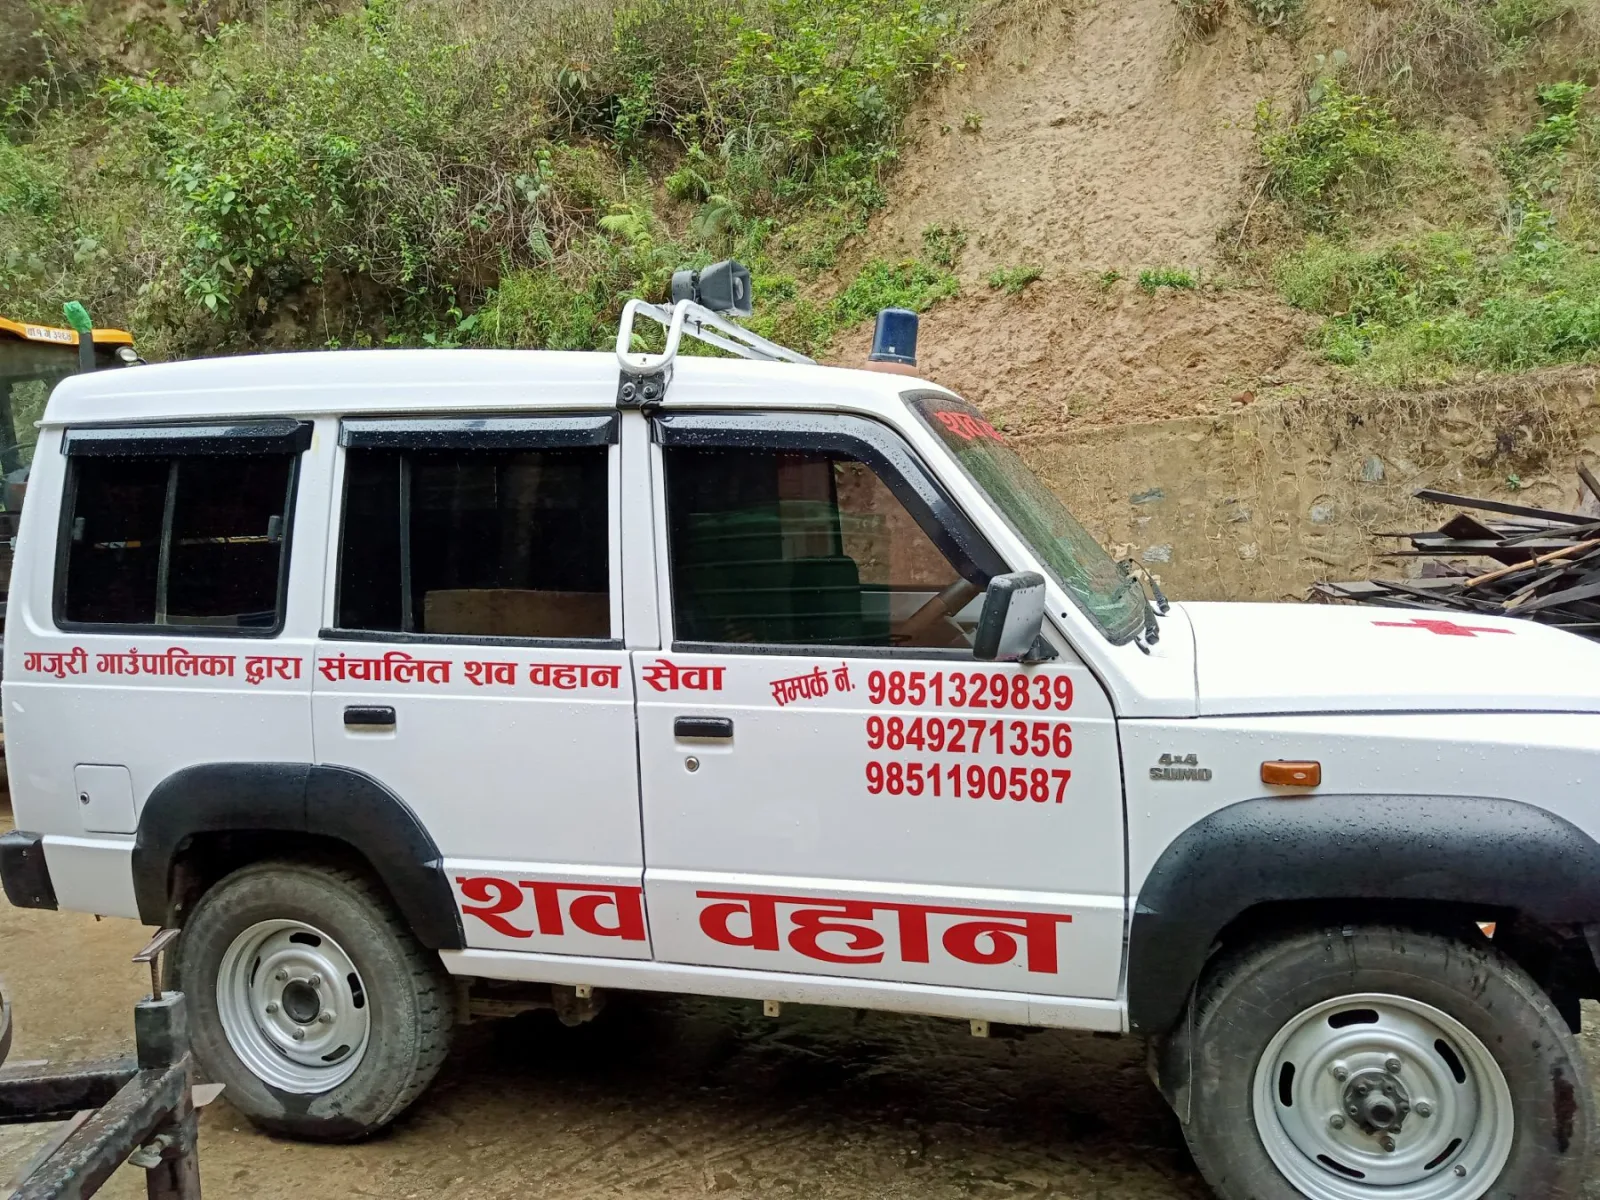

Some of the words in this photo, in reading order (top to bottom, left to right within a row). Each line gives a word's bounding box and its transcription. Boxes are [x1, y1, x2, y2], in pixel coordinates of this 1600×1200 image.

[24, 646, 88, 679] गजुरी
[96, 647, 236, 677] गाउँपालिका
[317, 651, 453, 684] संचालित
[464, 661, 518, 686] शव
[529, 663, 622, 690] वहान
[642, 658, 726, 693] सेवा
[769, 666, 827, 707] सम्पर्क
[867, 669, 1074, 711] 9851329839
[866, 715, 1073, 758] 9849271356
[865, 761, 1072, 804] 9851190587
[1149, 767, 1213, 781] SUMO
[455, 876, 647, 942] शव
[695, 889, 1073, 975] वहान
